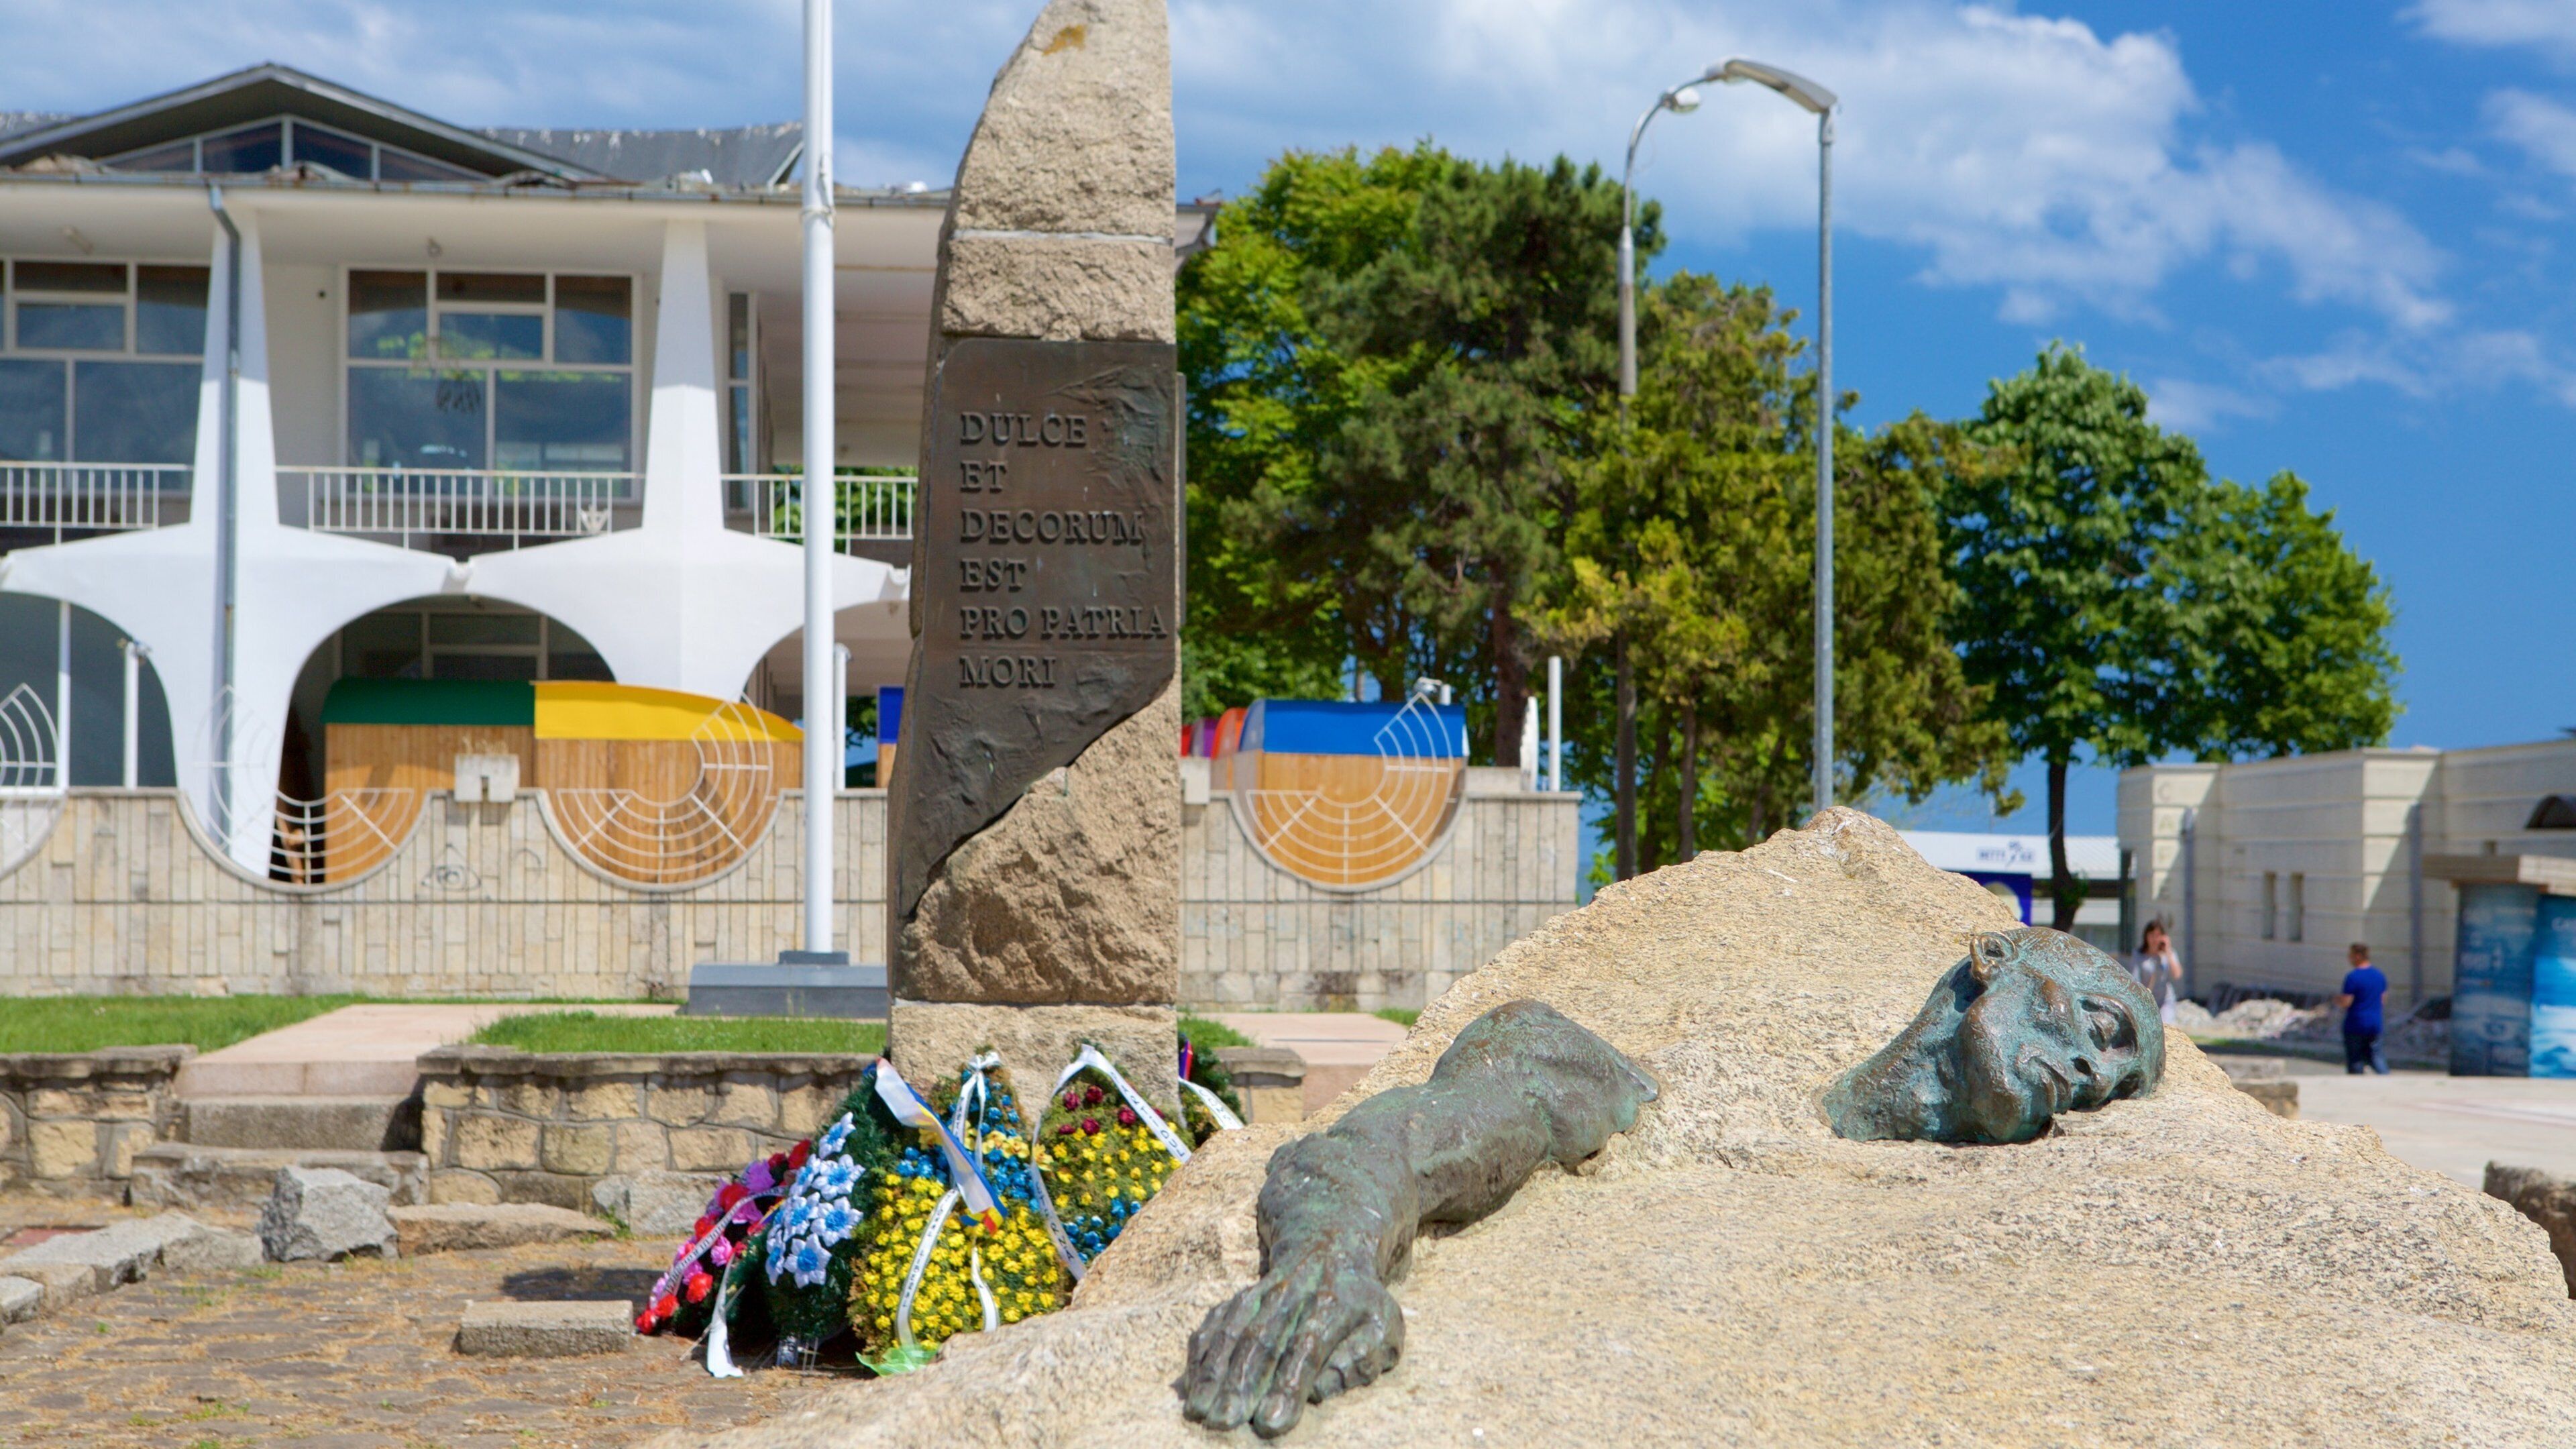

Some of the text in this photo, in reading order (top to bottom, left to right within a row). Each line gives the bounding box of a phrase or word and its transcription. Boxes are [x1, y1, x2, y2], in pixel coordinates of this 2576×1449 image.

[960, 412, 1087, 447] DULCE
[960, 460, 1008, 492] ET
[960, 508, 1144, 545] DECORUM
[960, 557, 1028, 592] EST
[960, 606, 1168, 639] PRO PATRIA
[959, 655, 1057, 690] MORI
